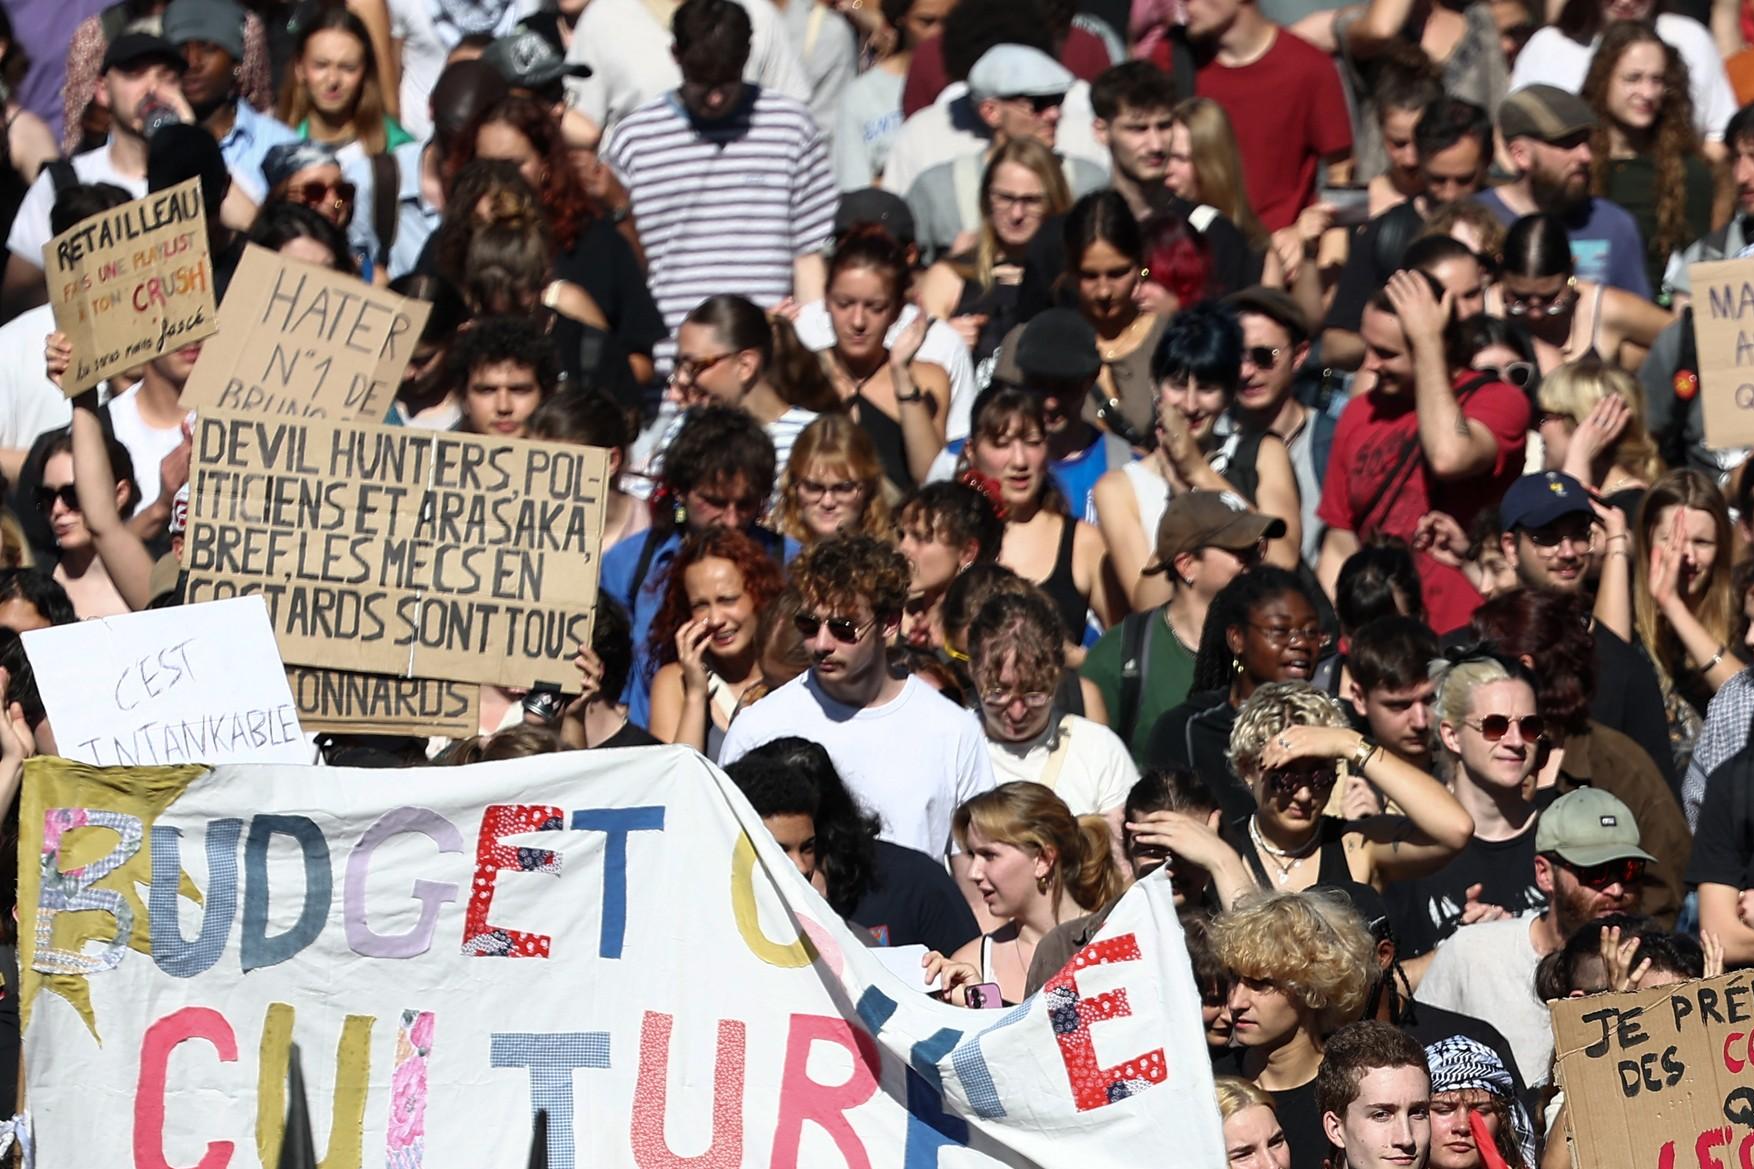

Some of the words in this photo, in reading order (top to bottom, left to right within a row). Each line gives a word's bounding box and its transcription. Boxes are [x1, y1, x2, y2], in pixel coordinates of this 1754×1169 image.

[57, 186, 199, 272] RETAILLEAU
[98, 258, 129, 282] UNE
[132, 262, 206, 312] CRUSH
[262, 267, 411, 359] HATER
[344, 373, 388, 416] DE
[200, 418, 320, 475] DEVIL
[197, 469, 348, 531] ITICIENS
[356, 484, 407, 538] ET
[380, 538, 486, 594] MECS
[492, 548, 544, 602] EN
[394, 594, 499, 655] SONT
[504, 606, 590, 662] TOUS
[289, 668, 469, 720] ONNARDS
[31, 804, 667, 980] BUDGET
[1581, 1006, 1650, 1059] JE
[1617, 1044, 1687, 1098] DES
